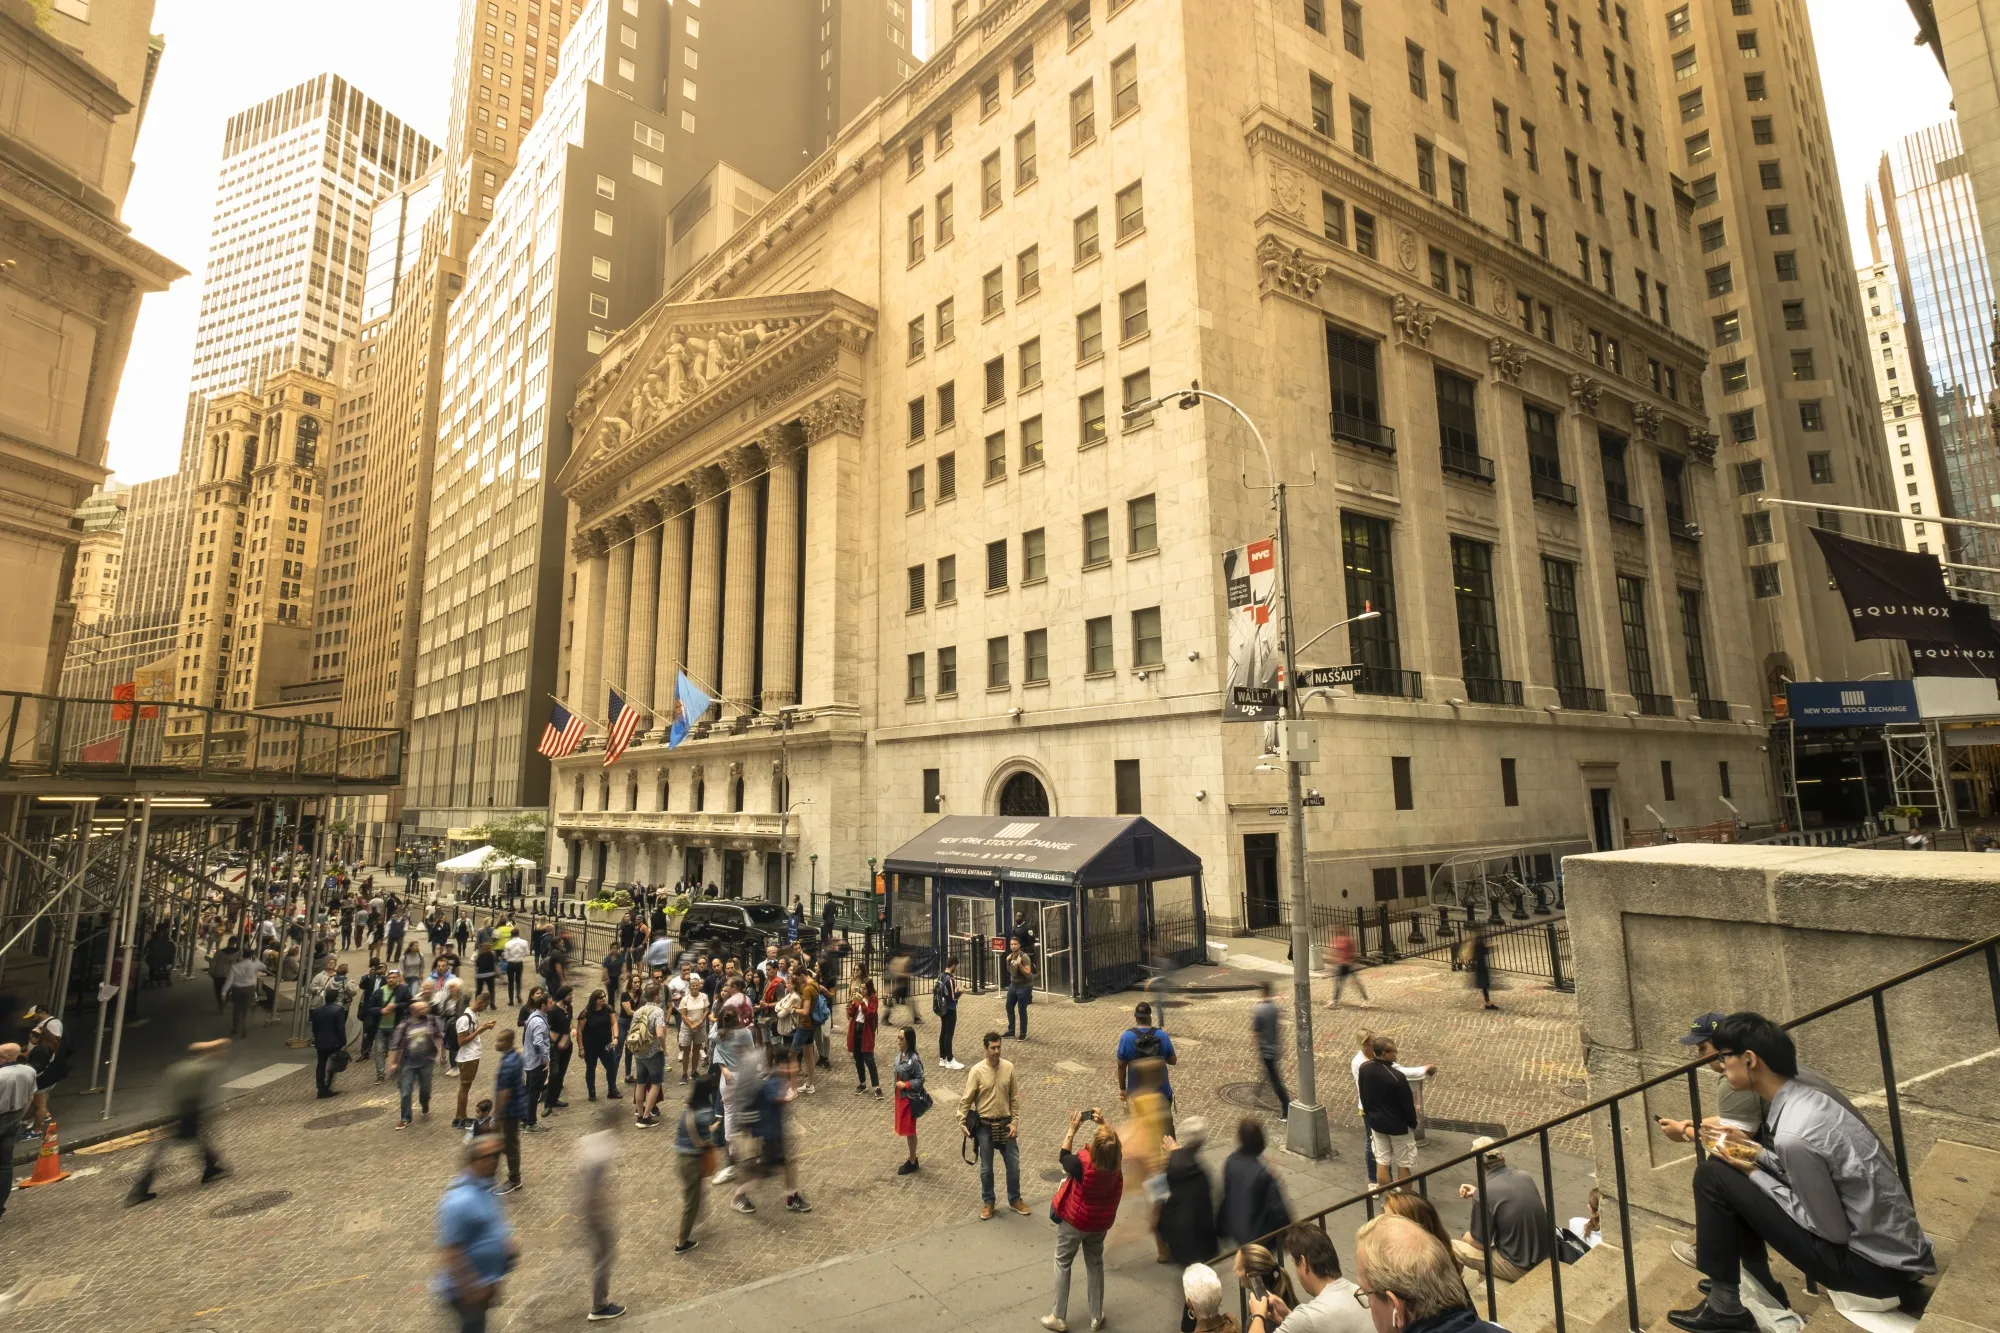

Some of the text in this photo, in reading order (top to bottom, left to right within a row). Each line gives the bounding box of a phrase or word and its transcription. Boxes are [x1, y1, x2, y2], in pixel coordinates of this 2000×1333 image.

[1251, 549, 1270, 561] NYC
[1853, 605, 1950, 617] EQUINOX
[1914, 649, 1994, 659] EQUINOX
[1315, 670, 1353, 684] NASSAU
[1237, 691, 1262, 703] WALL
[959, 836, 985, 845] YORK
[983, 838, 1015, 847] STOCK
[1015, 838, 1077, 850] EXCHANGE
[944, 867, 992, 877] EMPLOYEE ENTRANCE
[1009, 870, 1066, 881] REGISTERED GUESTS
